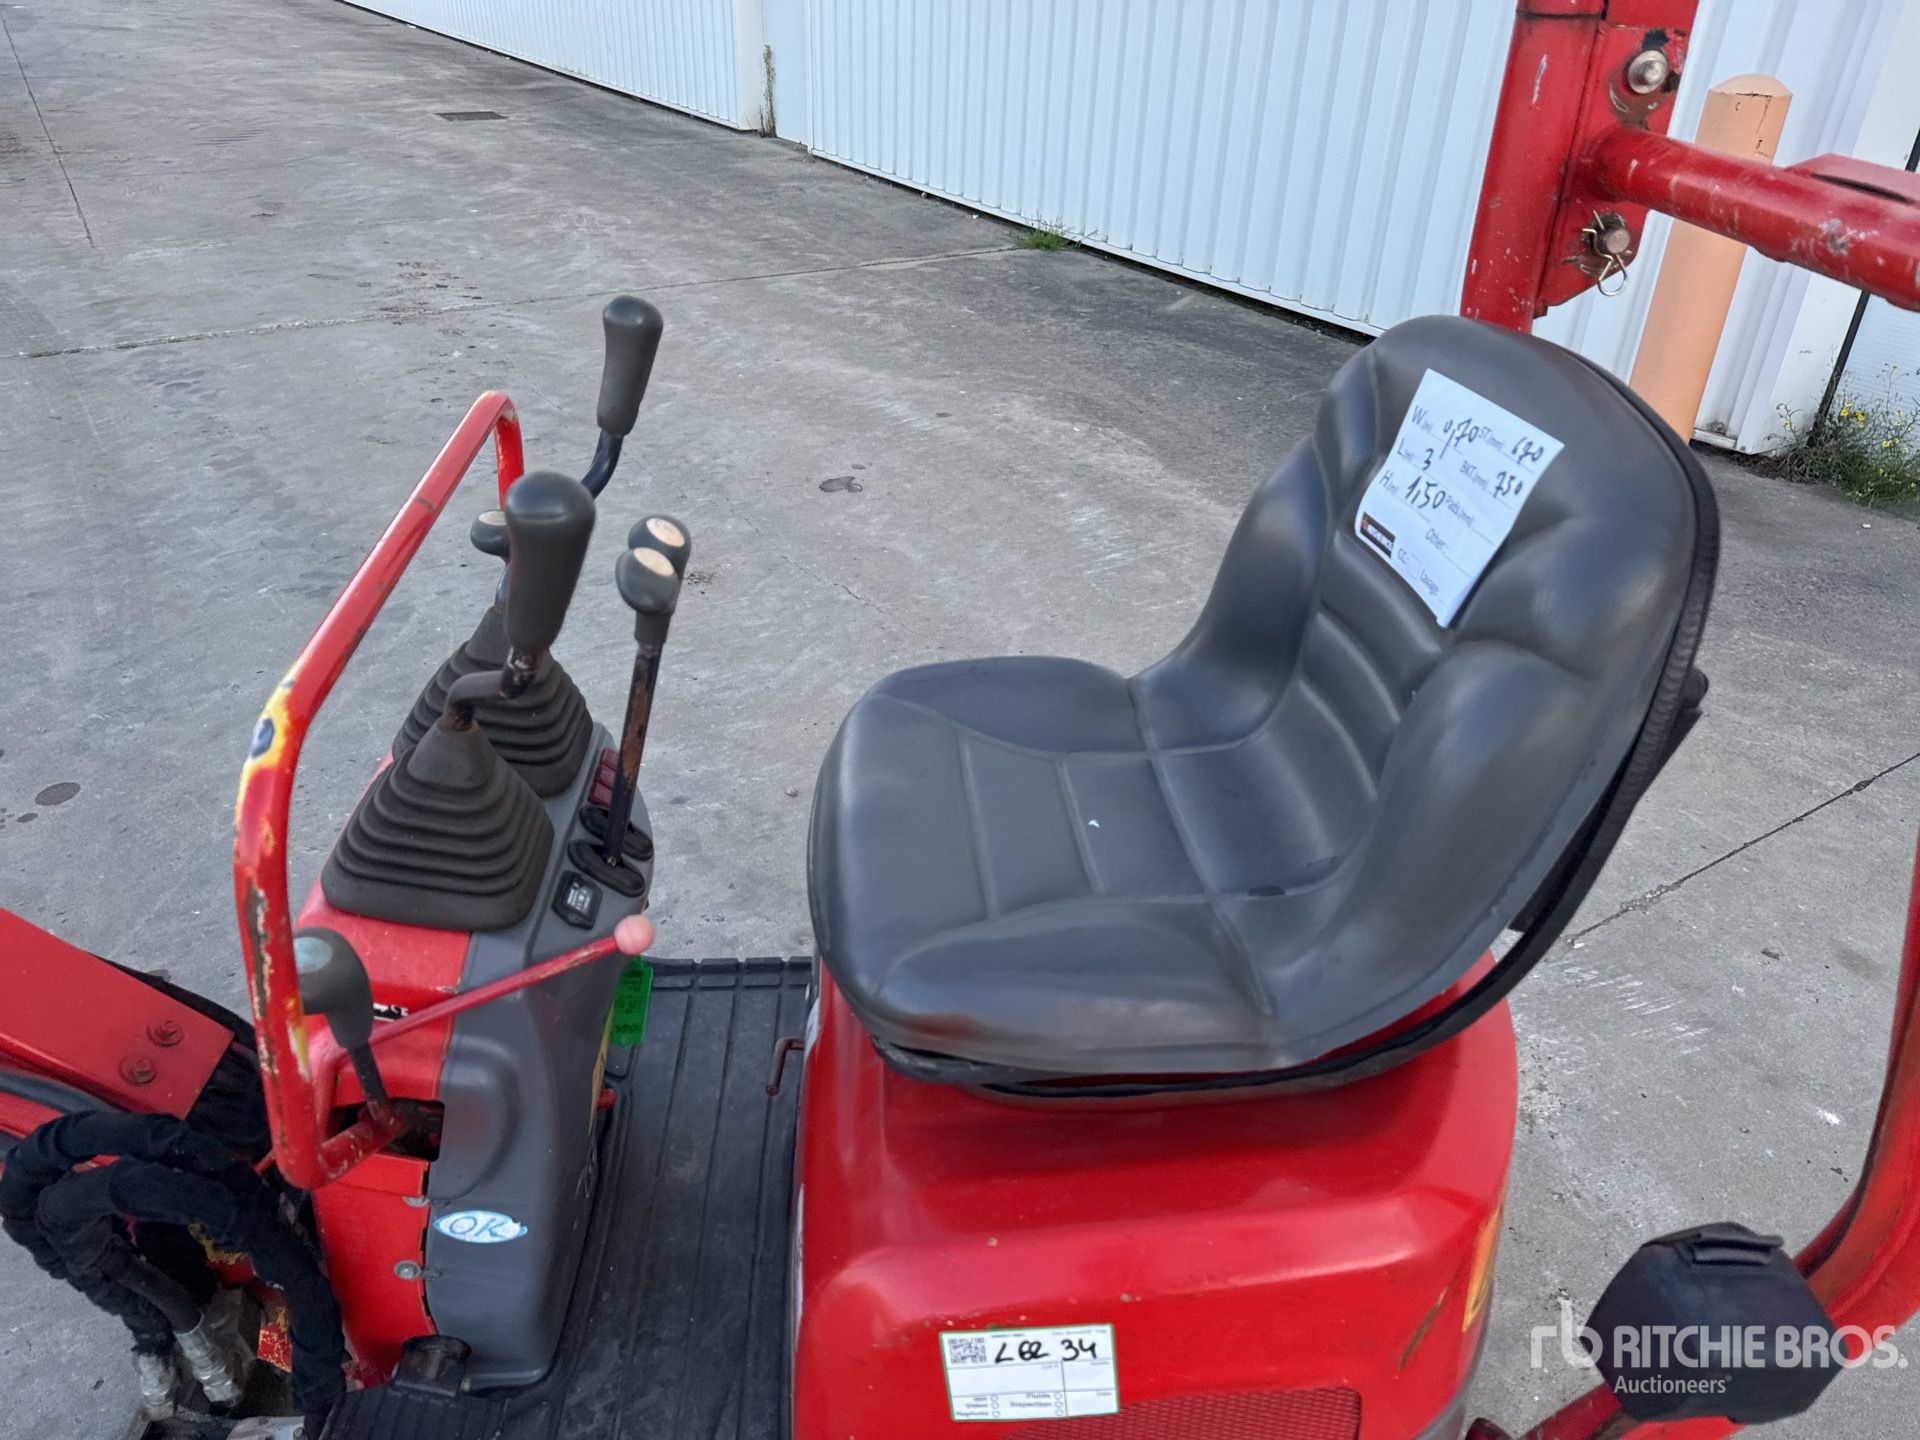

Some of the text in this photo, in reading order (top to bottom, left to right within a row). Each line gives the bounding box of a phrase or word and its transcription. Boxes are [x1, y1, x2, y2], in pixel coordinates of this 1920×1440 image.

[1422, 448, 1434, 471] 3
[449, 1216, 508, 1238] OK
[1061, 1338, 1097, 1362] 34
